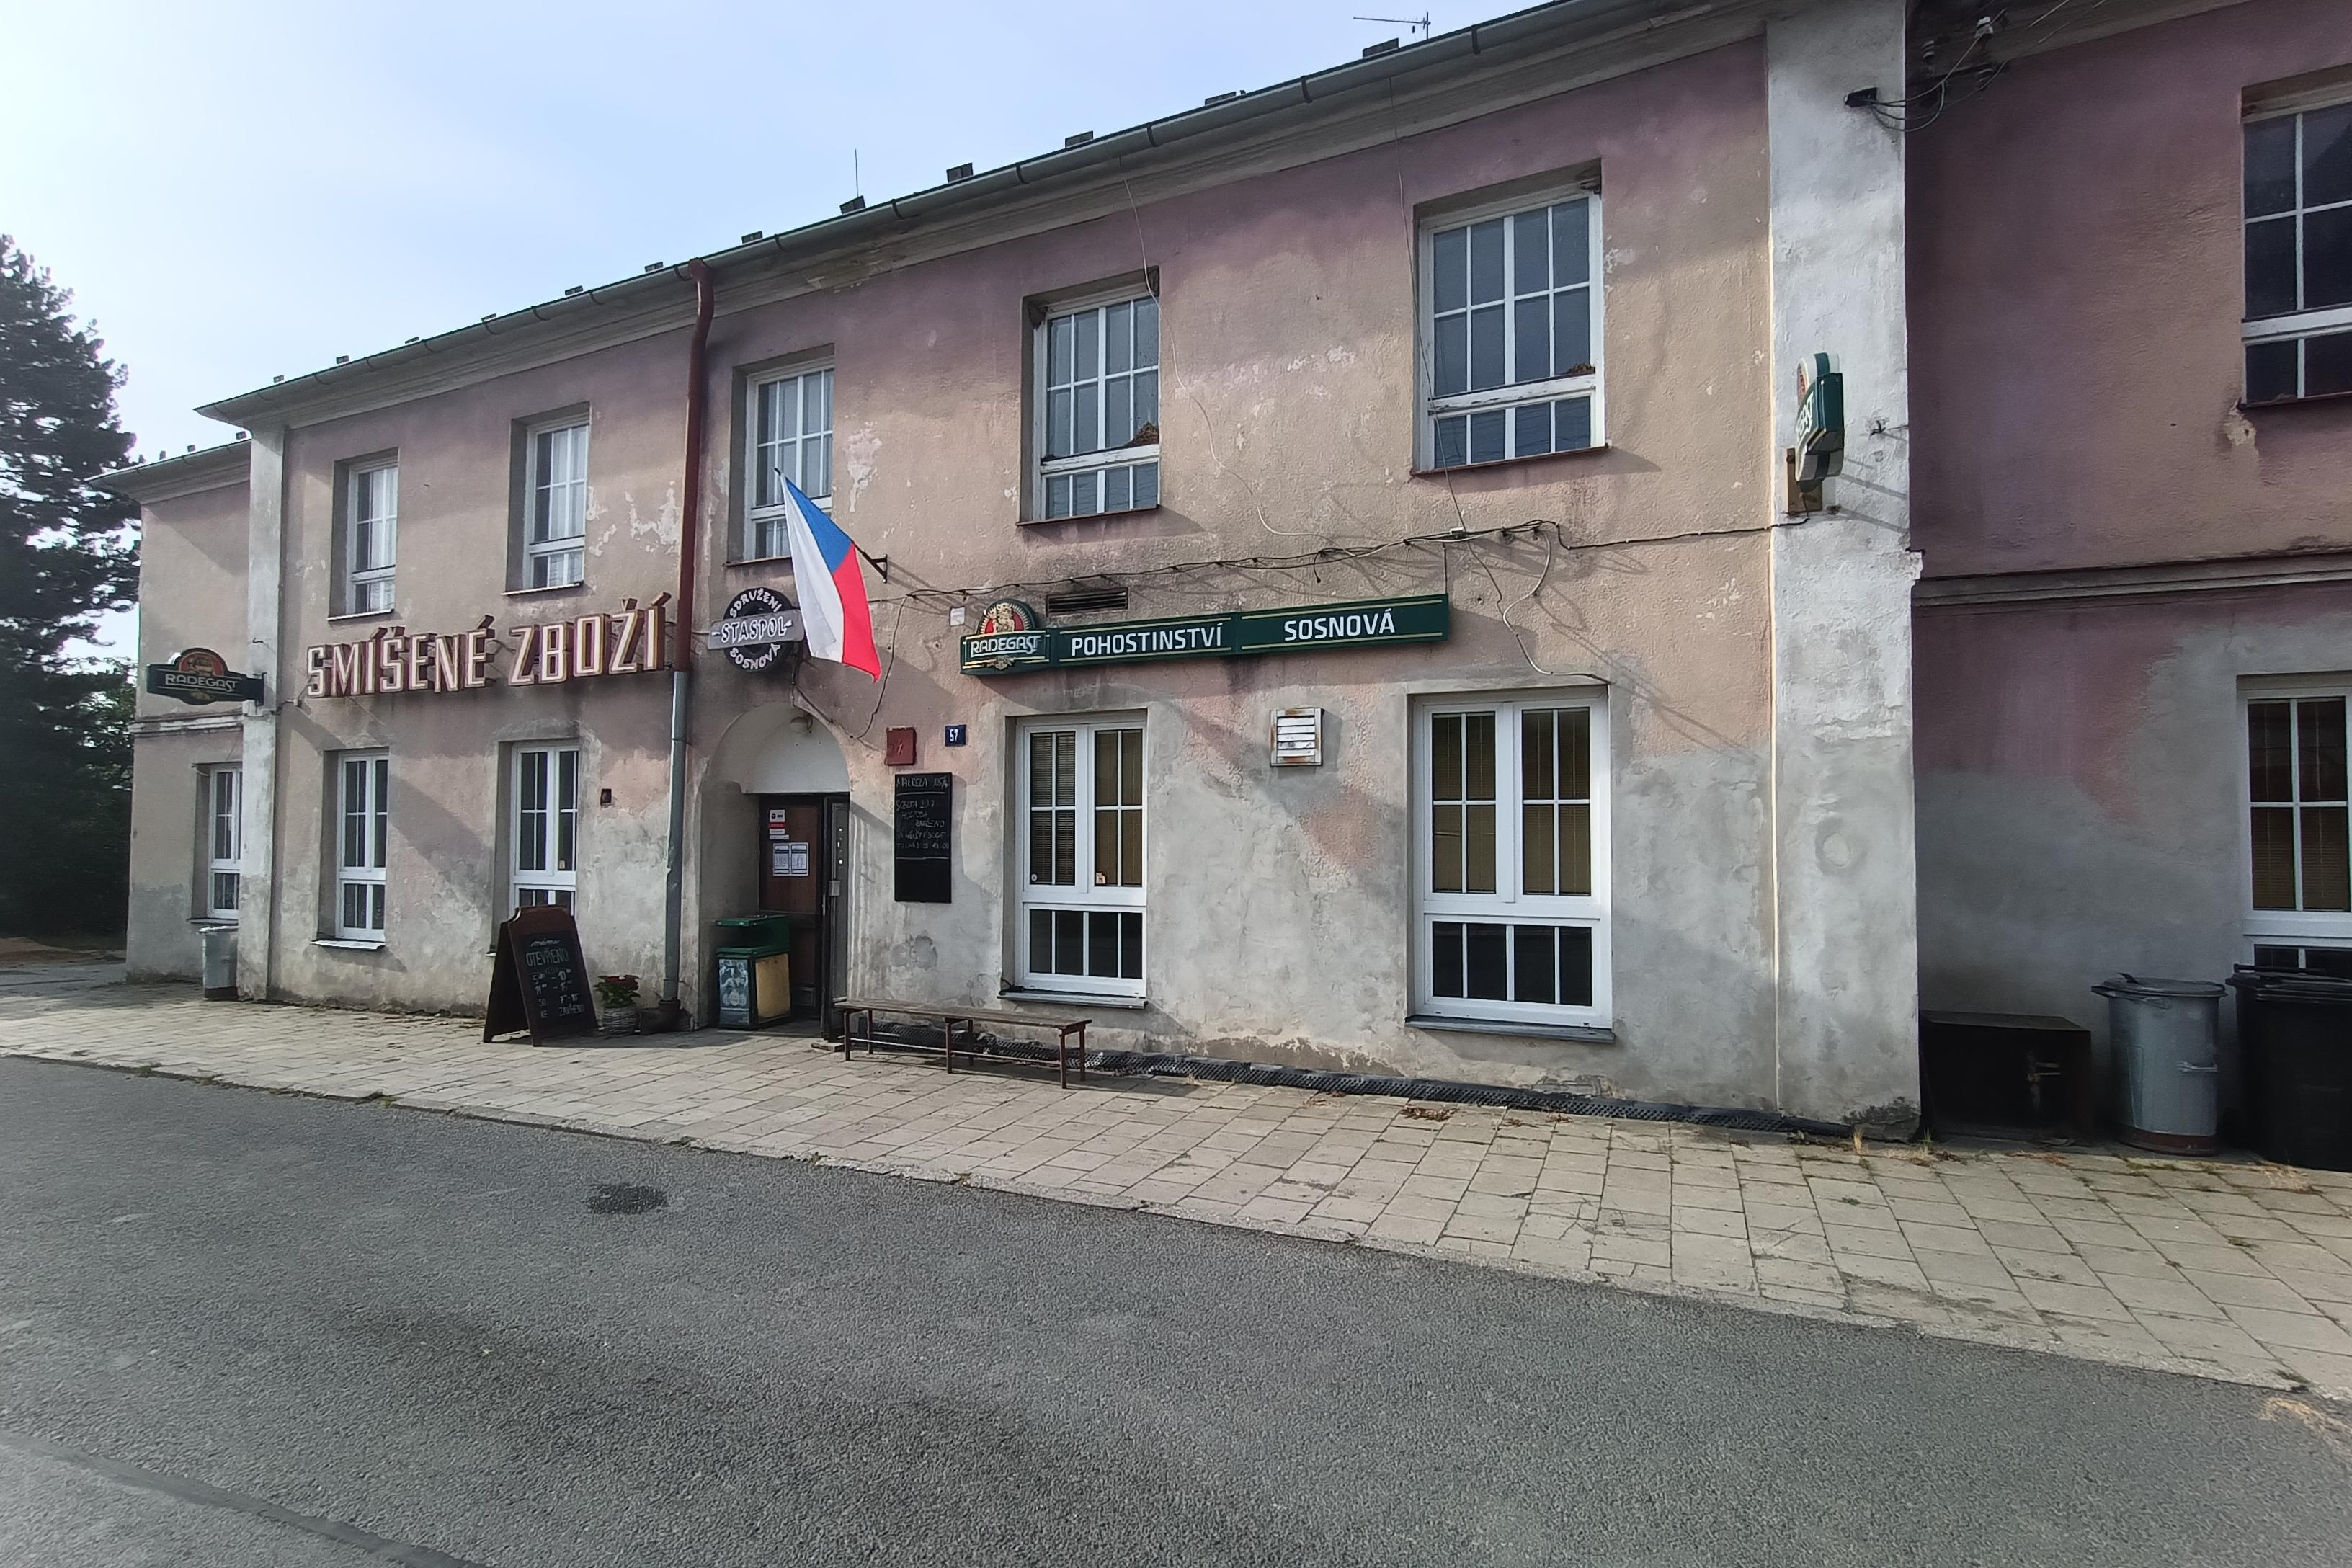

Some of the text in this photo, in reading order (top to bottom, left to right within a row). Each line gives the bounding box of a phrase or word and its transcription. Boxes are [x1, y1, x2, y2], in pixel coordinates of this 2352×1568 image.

[1071, 607, 1396, 657] POHOSTINSTVÍ SOSNOVÁ
[307, 592, 671, 698] SMÍŠENÉ ZBOŽÍ
[970, 635, 1042, 658] RADEGAST
[165, 673, 239, 692] RADEGAST
[950, 729, 958, 742] 57
